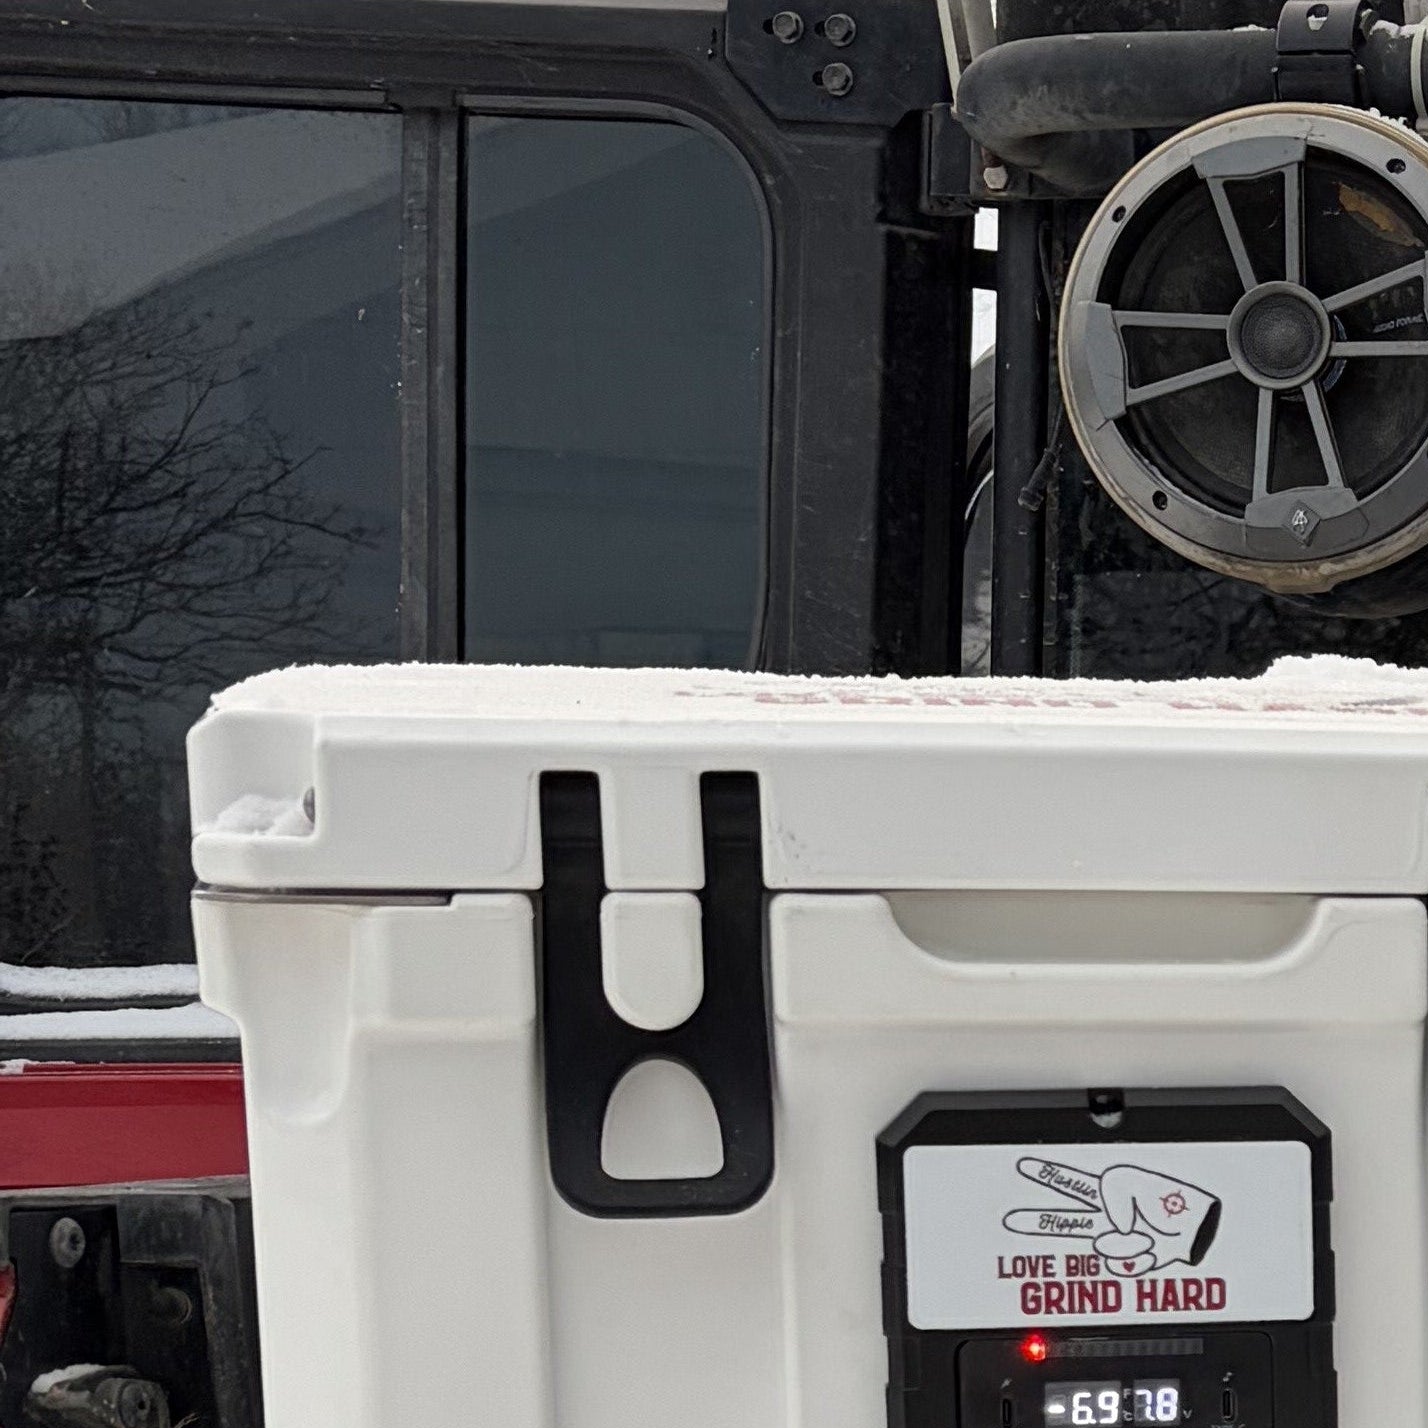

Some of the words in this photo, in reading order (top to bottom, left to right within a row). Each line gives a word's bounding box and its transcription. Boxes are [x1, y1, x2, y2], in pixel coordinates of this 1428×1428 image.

[1038, 1213, 1094, 1233] Hippie
[998, 1254, 1057, 1279] LOVE
[1065, 1253, 1100, 1278] BIG
[1020, 1280, 1122, 1316] GRIND
[1135, 1277, 1227, 1313] HARD
